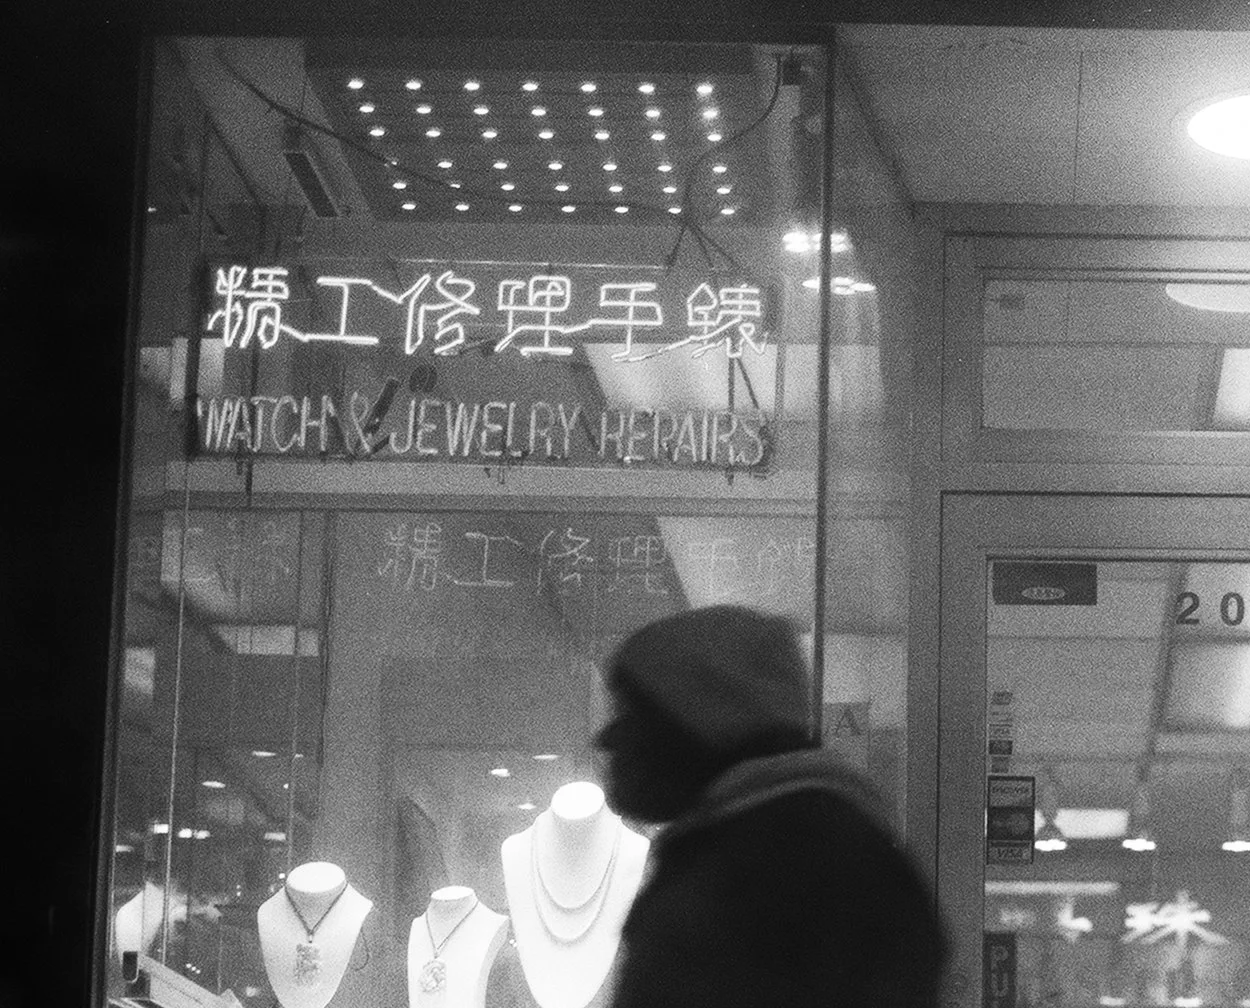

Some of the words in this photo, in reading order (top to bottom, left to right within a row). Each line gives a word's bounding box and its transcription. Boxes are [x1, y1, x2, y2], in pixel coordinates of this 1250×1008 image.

[207, 265, 769, 362] 精工修理手錶
[196, 395, 334, 453] WATCH
[345, 391, 373, 453] &
[389, 397, 580, 458] JEWELRY
[596, 407, 766, 466] REPAIRS
